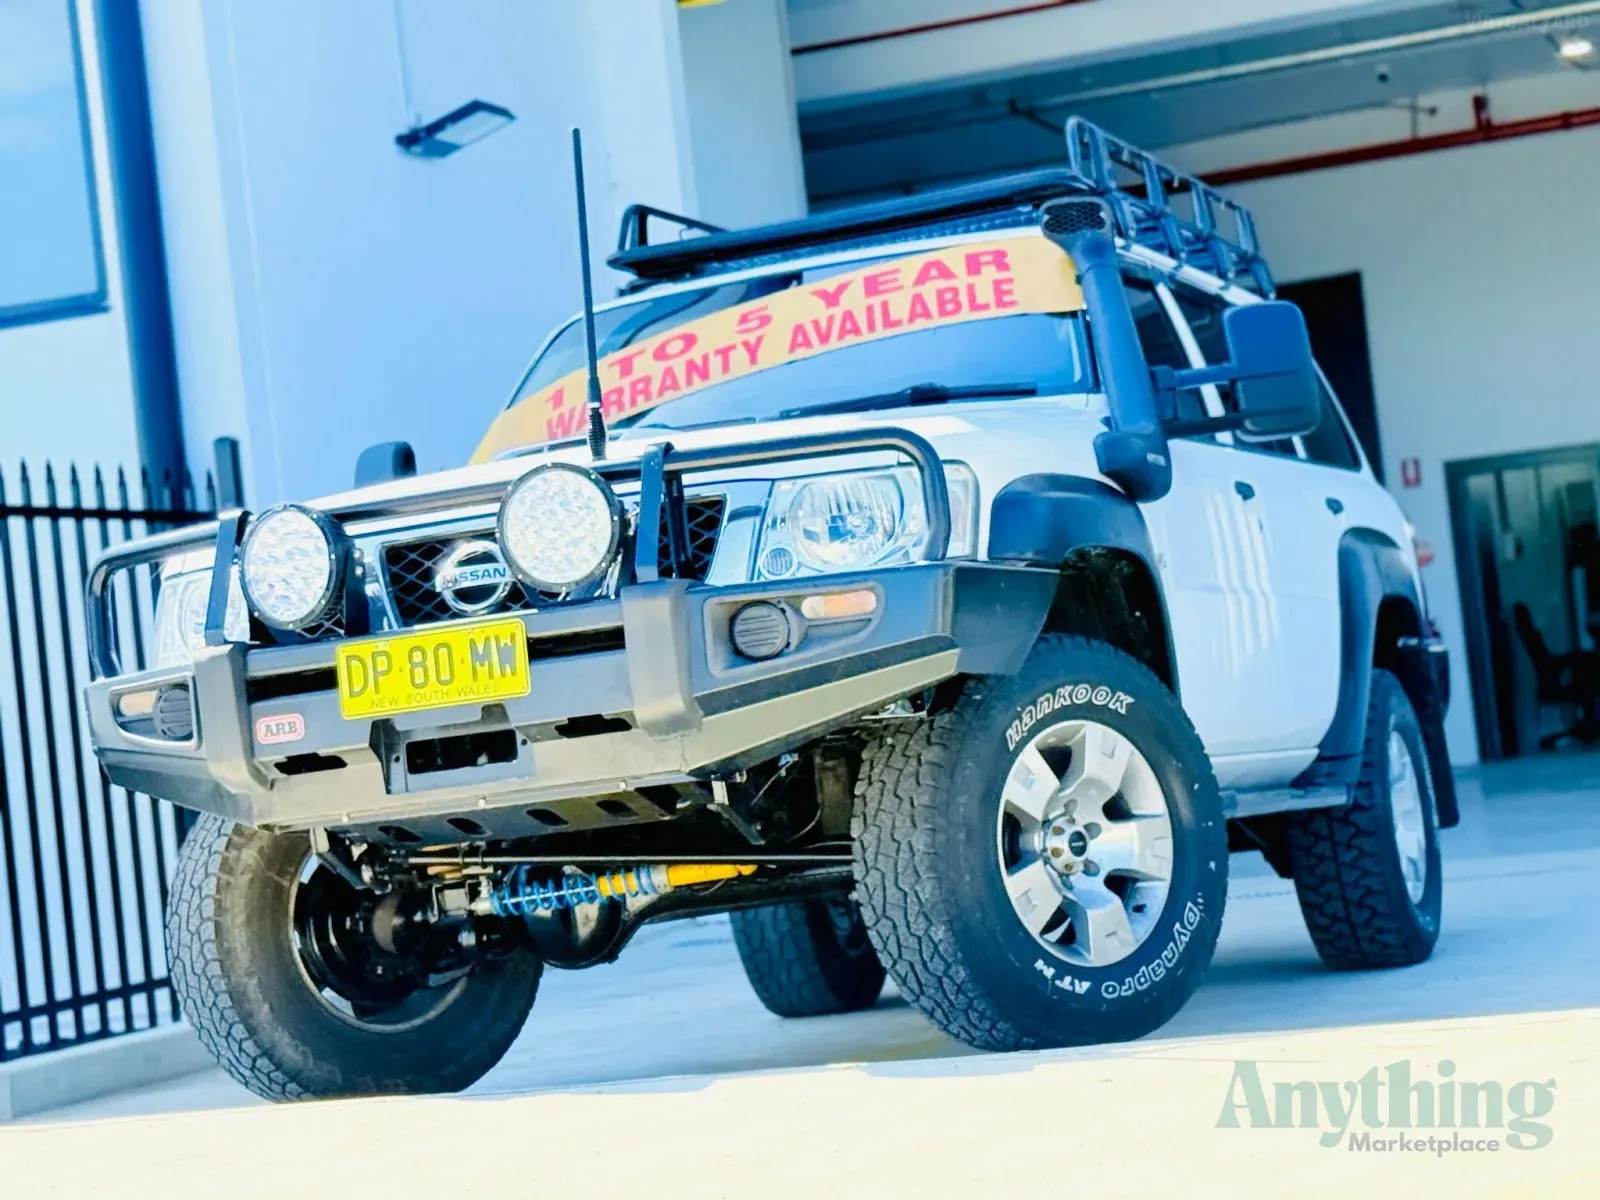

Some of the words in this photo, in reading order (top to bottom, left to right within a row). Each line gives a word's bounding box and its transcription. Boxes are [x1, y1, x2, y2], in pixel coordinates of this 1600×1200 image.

[543, 386, 564, 411] 1
[607, 333, 698, 380] TO
[735, 305, 773, 334] 5
[809, 249, 1012, 308] YEAR
[788, 277, 1018, 354] AVAILABLE
[443, 567, 506, 585] NISSAN
[346, 651, 393, 698] DP
[408, 642, 455, 689] 80
[469, 632, 517, 682] MW
[371, 696, 399, 709] NEW
[406, 688, 451, 705] SOUTH
[456, 682, 500, 698] WALES
[264, 720, 298, 738] ARB
